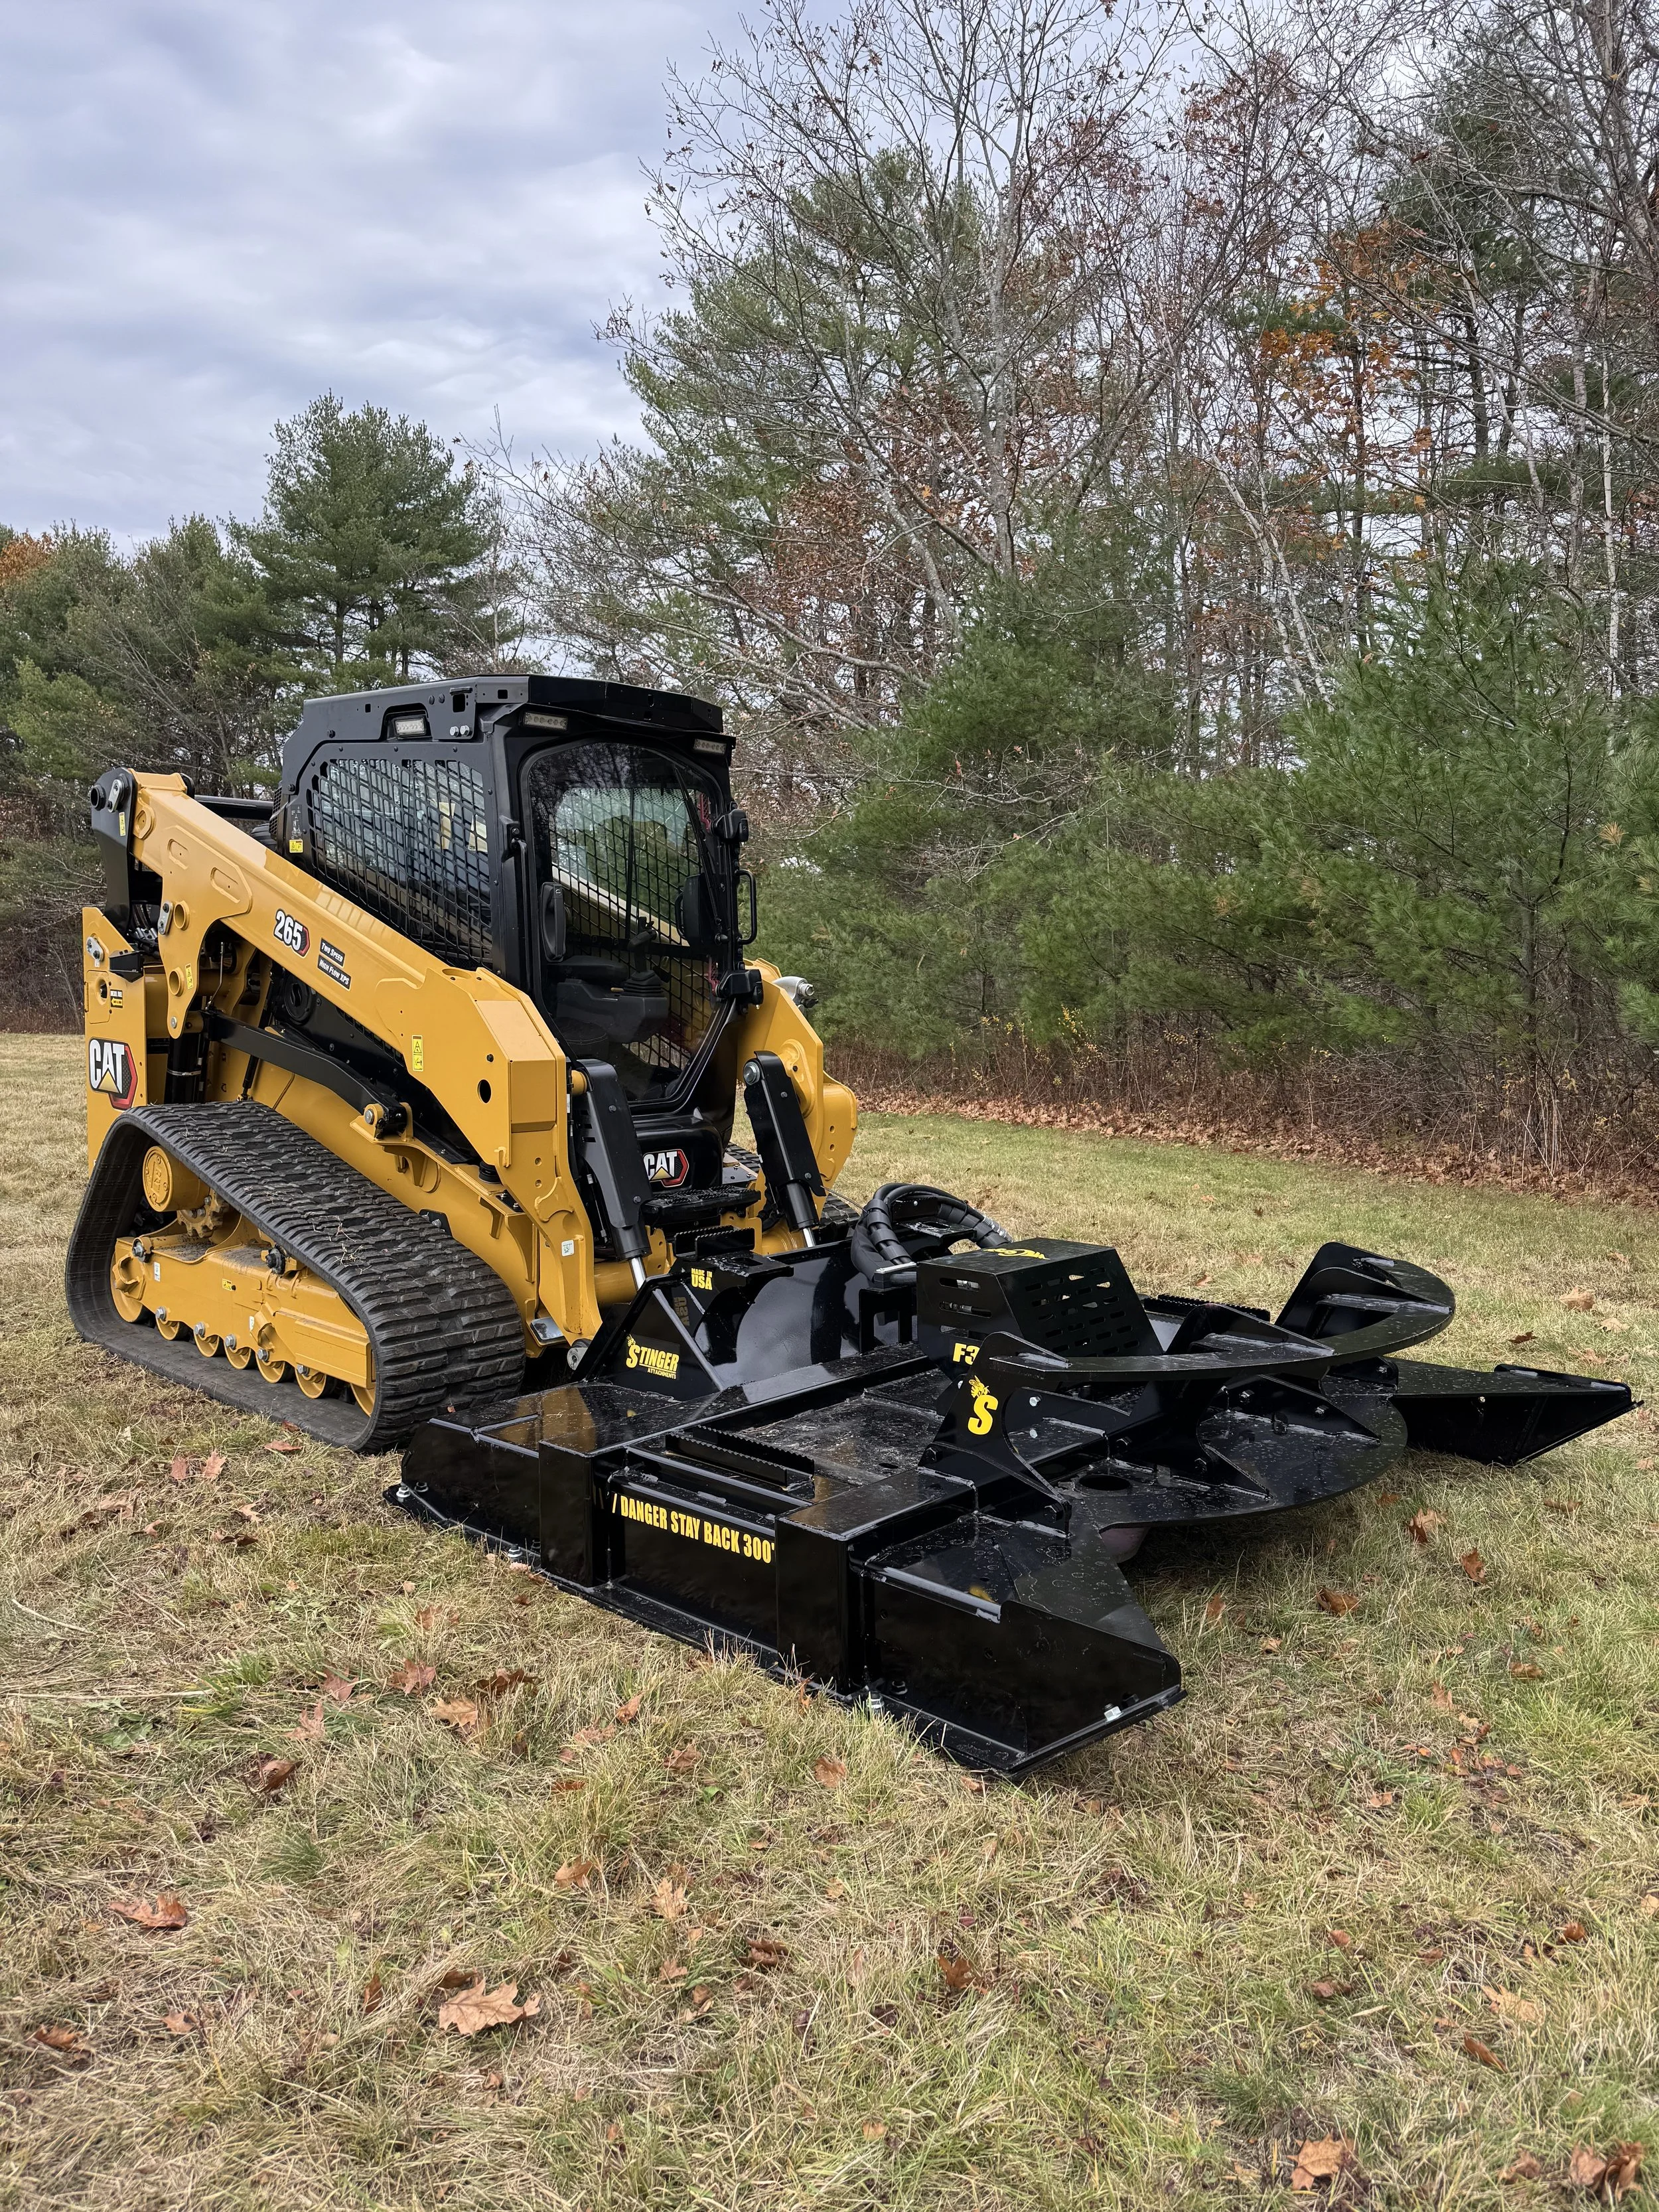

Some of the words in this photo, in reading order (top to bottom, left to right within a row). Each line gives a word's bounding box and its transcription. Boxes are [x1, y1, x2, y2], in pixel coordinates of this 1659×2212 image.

[274, 910, 303, 950] 265
[340, 973, 350, 985] XPS
[89, 1039, 125, 1094] CAT
[643, 1151, 678, 1181] CAT
[691, 1268, 705, 1276] MADE
[691, 1274, 713, 1291] USA
[626, 1344, 680, 1372] STINGER
[647, 1367, 677, 1379] ATTACHMENTS
[968, 1394, 999, 1435] S
[620, 1495, 668, 1530] DANGER
[670, 1511, 701, 1540] STAY
[703, 1520, 741, 1554] BACK
